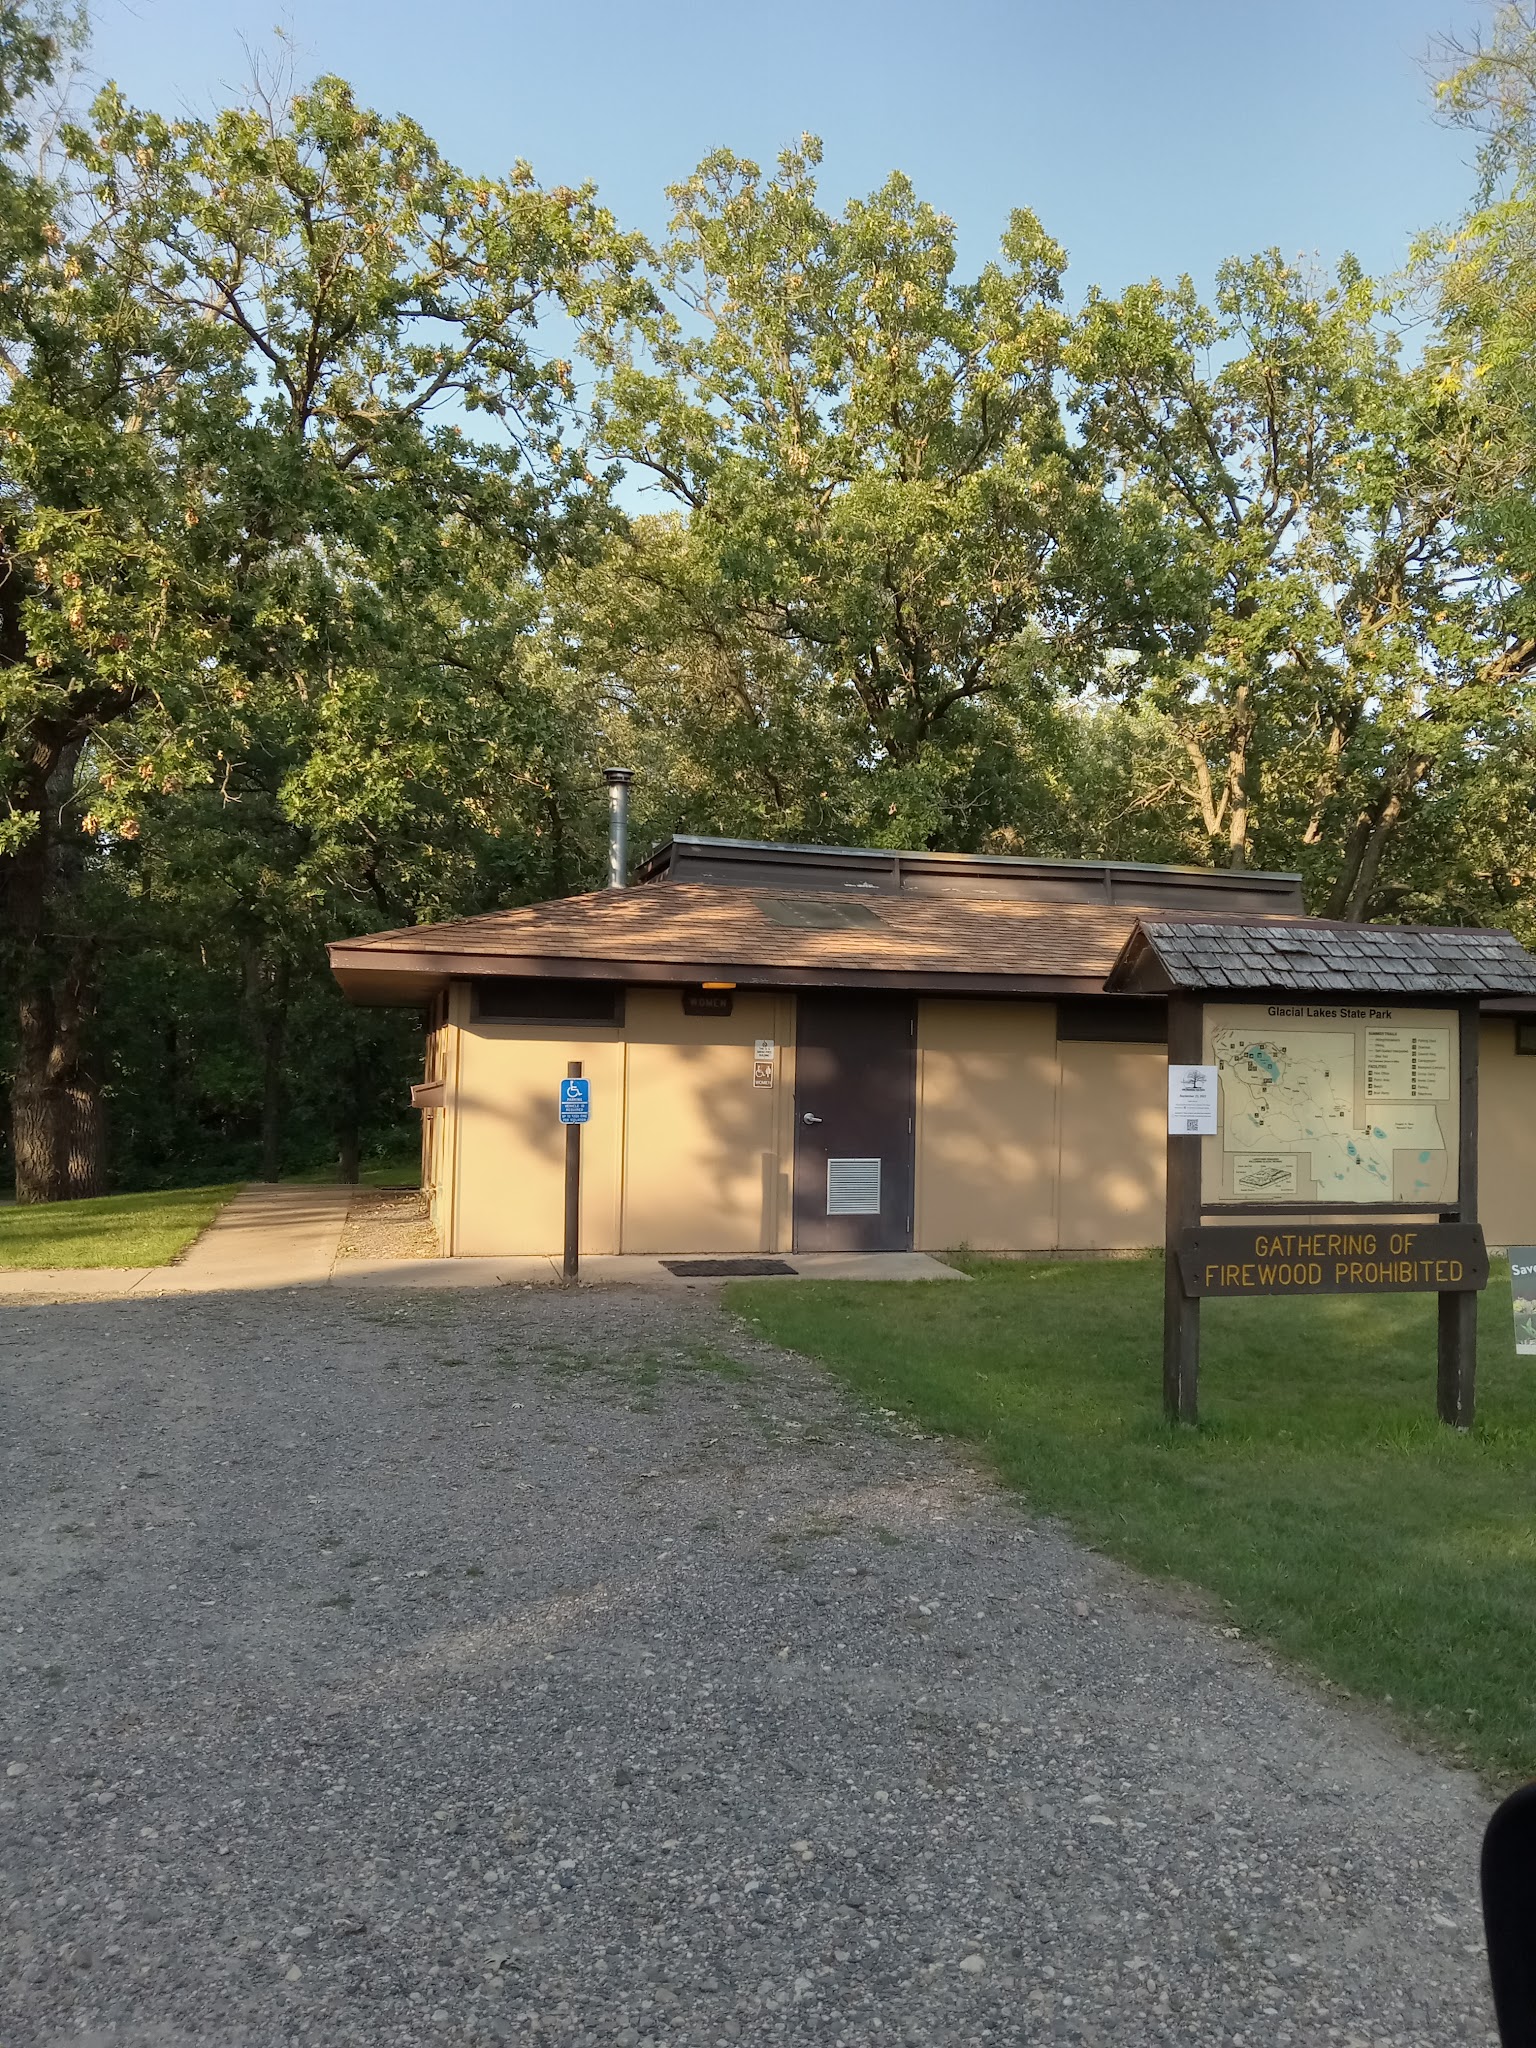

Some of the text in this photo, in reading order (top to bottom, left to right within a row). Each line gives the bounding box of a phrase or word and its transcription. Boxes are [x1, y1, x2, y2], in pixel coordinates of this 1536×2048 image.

[690, 998, 727, 1007] WOMEN
[1268, 1006, 1392, 1019] Glacial Lakes State Park
[1254, 1233, 1418, 1257] GATHERING OF
[1205, 1260, 1463, 1287] FIREWOOD PROHIBITED
